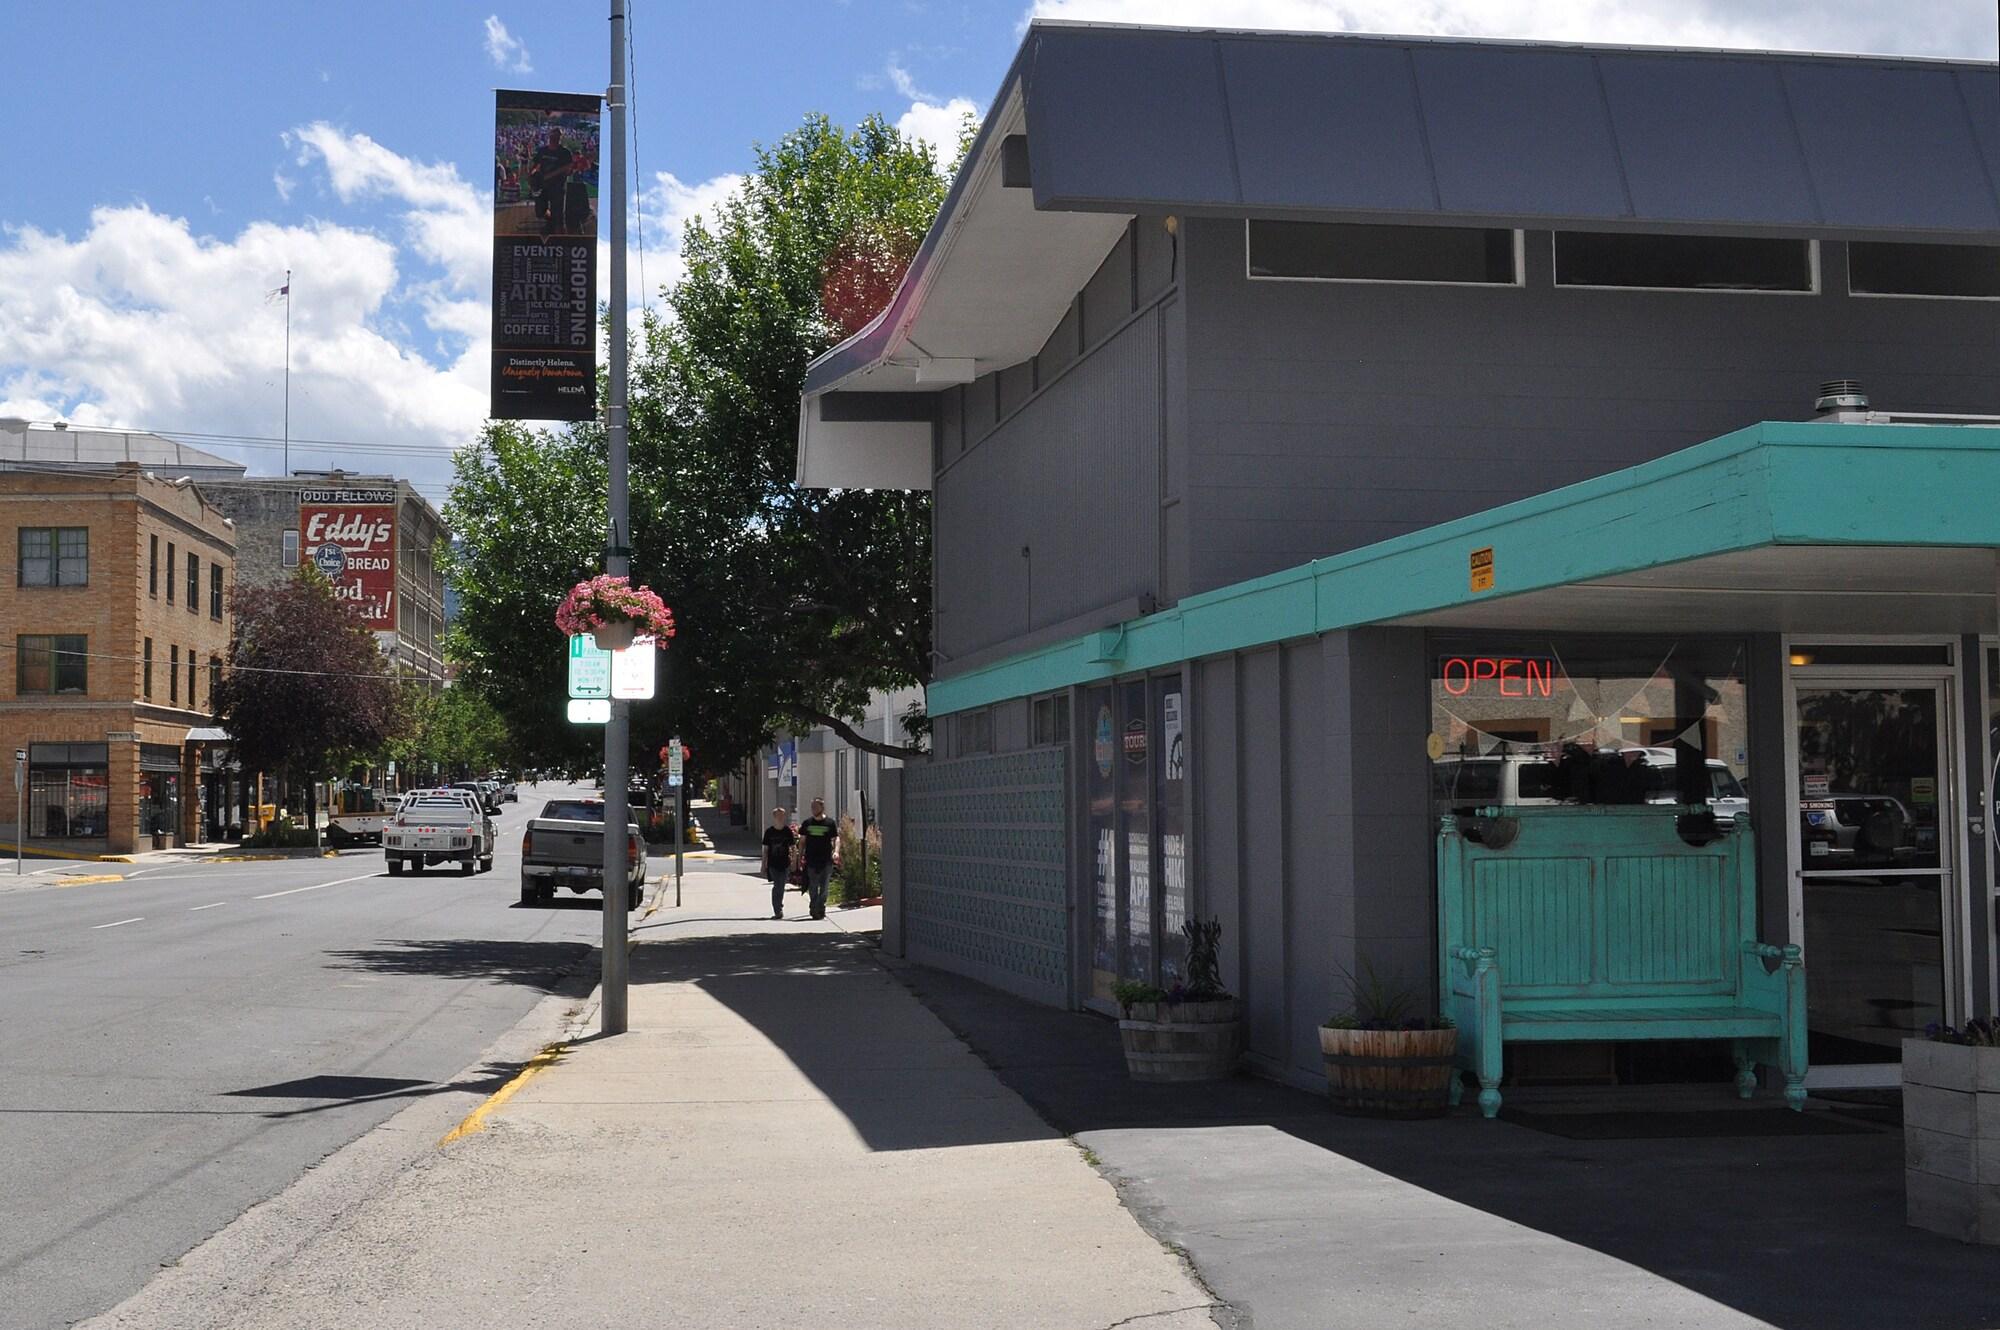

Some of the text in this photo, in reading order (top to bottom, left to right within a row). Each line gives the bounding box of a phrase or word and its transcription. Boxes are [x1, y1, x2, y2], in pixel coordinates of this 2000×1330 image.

[513, 246, 564, 257] EVENTS
[532, 273, 558, 284] FUN!
[510, 284, 563, 301] ARTS
[570, 246, 588, 345] SHOPPING
[530, 301, 571, 310] ICE CREAM
[503, 324, 551, 335] COFFEE
[509, 358, 576, 367] Distinctly Helena.
[502, 366, 541, 380] Uniquely
[557, 385, 586, 394] HELENA
[303, 490, 393, 501] ODD FELLOWS
[306, 512, 393, 552] Eddy's
[347, 558, 390, 570] BREAD
[1443, 657, 1552, 697] OPEN
[1124, 735, 1147, 749] TOUR
[1129, 876, 1149, 907] APP
